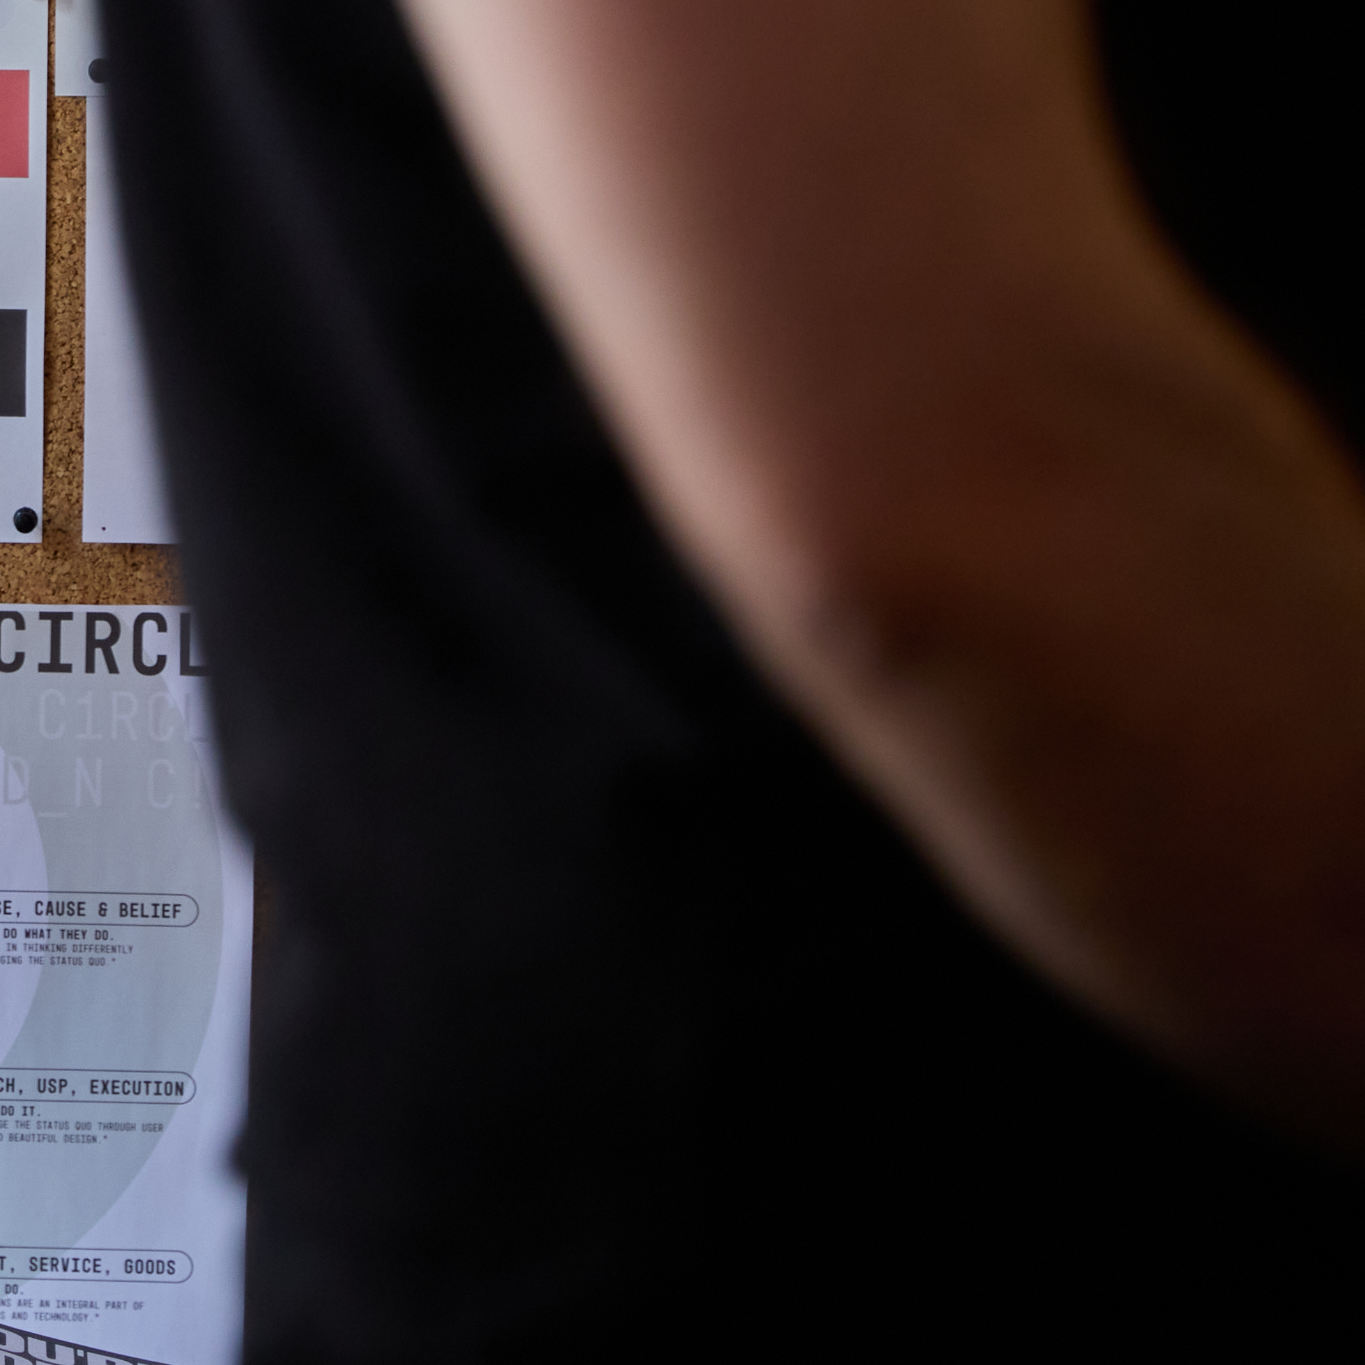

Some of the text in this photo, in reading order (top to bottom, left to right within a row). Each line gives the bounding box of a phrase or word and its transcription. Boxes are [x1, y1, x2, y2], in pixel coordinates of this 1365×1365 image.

[35, 901, 85, 916] CAUSE
[99, 902, 107, 917] &
[120, 903, 181, 918] BELIEF
[4, 928, 17, 938] DO
[25, 929, 51, 938] WHAT
[60, 929, 86, 940] THEY
[95, 930, 113, 940] DO.
[7, 943, 17, 951] IN
[24, 943, 67, 952] THINKING
[72, 944, 133, 953] DIFFERENTLY
[29, 956, 44, 965] THE
[50, 956, 82, 965] STATUS
[38, 1079, 75, 1095] USP,
[90, 1080, 183, 1096] EXECUTION
[1, 1106, 14, 1116] DO
[23, 1106, 40, 1116] IT.
[29, 1257, 109, 1274] SERVICE,
[125, 1259, 175, 1275] GOODS
[5, 1284, 24, 1295] DO.
